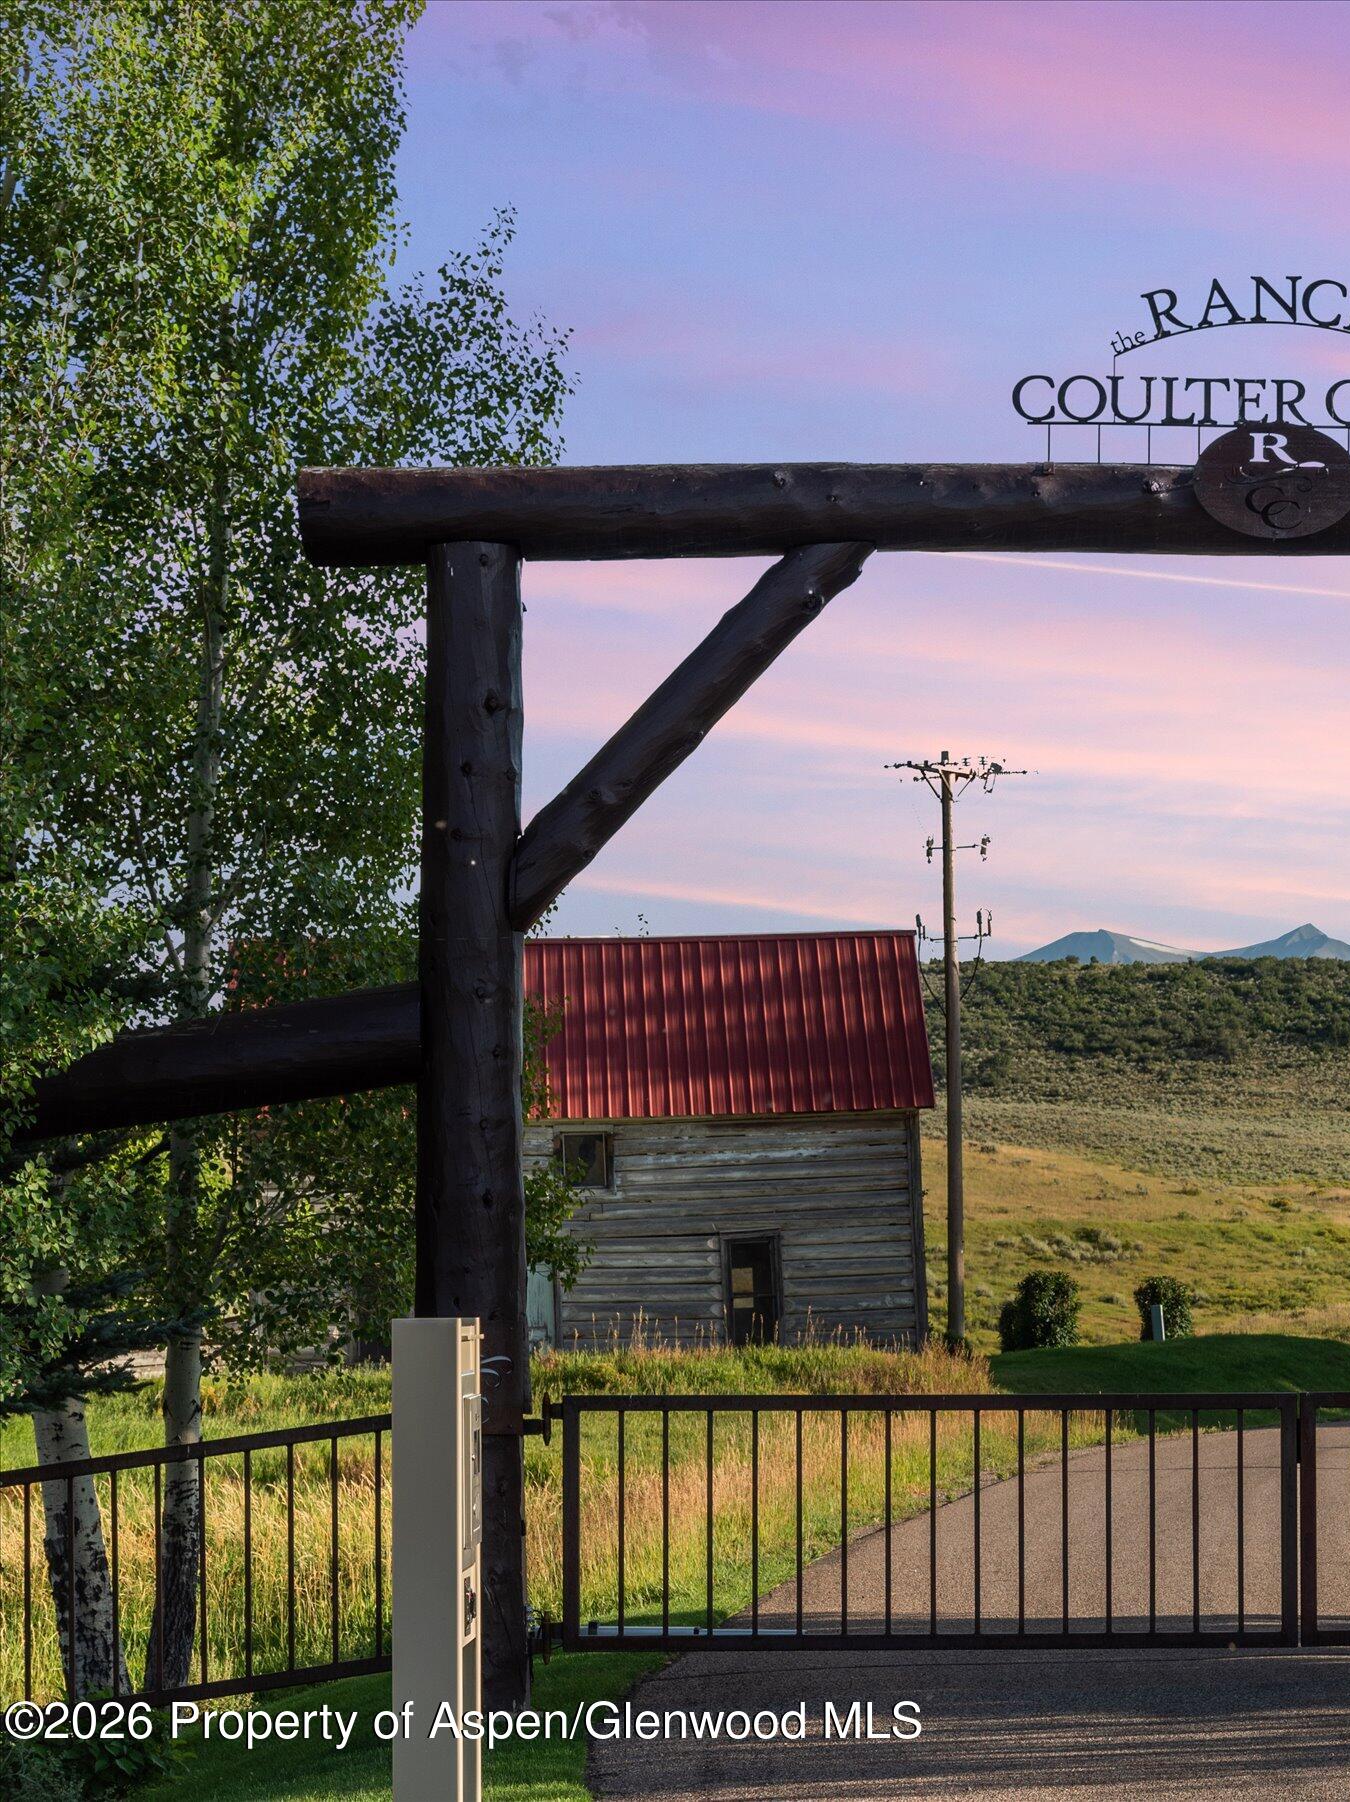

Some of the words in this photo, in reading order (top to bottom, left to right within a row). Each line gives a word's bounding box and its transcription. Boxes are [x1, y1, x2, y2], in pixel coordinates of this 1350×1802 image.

[1110, 327, 1147, 356] the
[1011, 374, 1314, 428] COULTER
[1249, 432, 1298, 466] R
